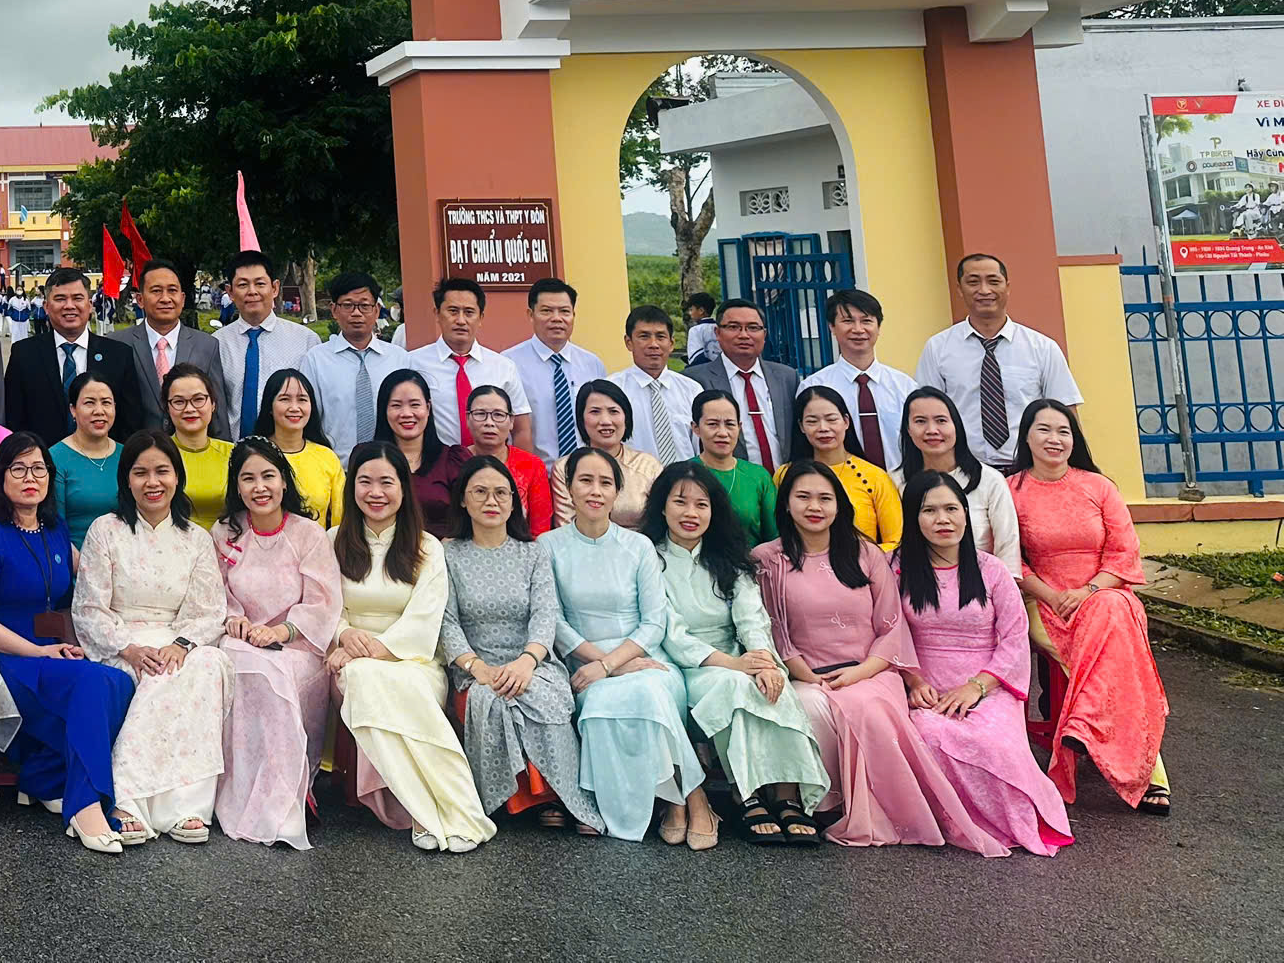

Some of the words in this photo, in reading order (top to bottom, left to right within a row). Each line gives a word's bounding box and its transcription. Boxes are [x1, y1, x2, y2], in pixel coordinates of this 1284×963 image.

[1256, 99, 1271, 108] XE
[447, 206, 476, 225] TRƯỜNG
[476, 209, 494, 224] THCS
[494, 206, 504, 224] VÀ
[505, 209, 523, 224] THPT
[524, 209, 530, 224] Y
[530, 206, 546, 225] ĐÔN
[450, 239, 468, 269] ĐẠT
[471, 228, 504, 264] CHUẨN
[504, 231, 531, 267] QUỐC
[532, 239, 548, 263] GIA
[476, 271, 500, 282] NĂM
[502, 273, 525, 282] 2021
